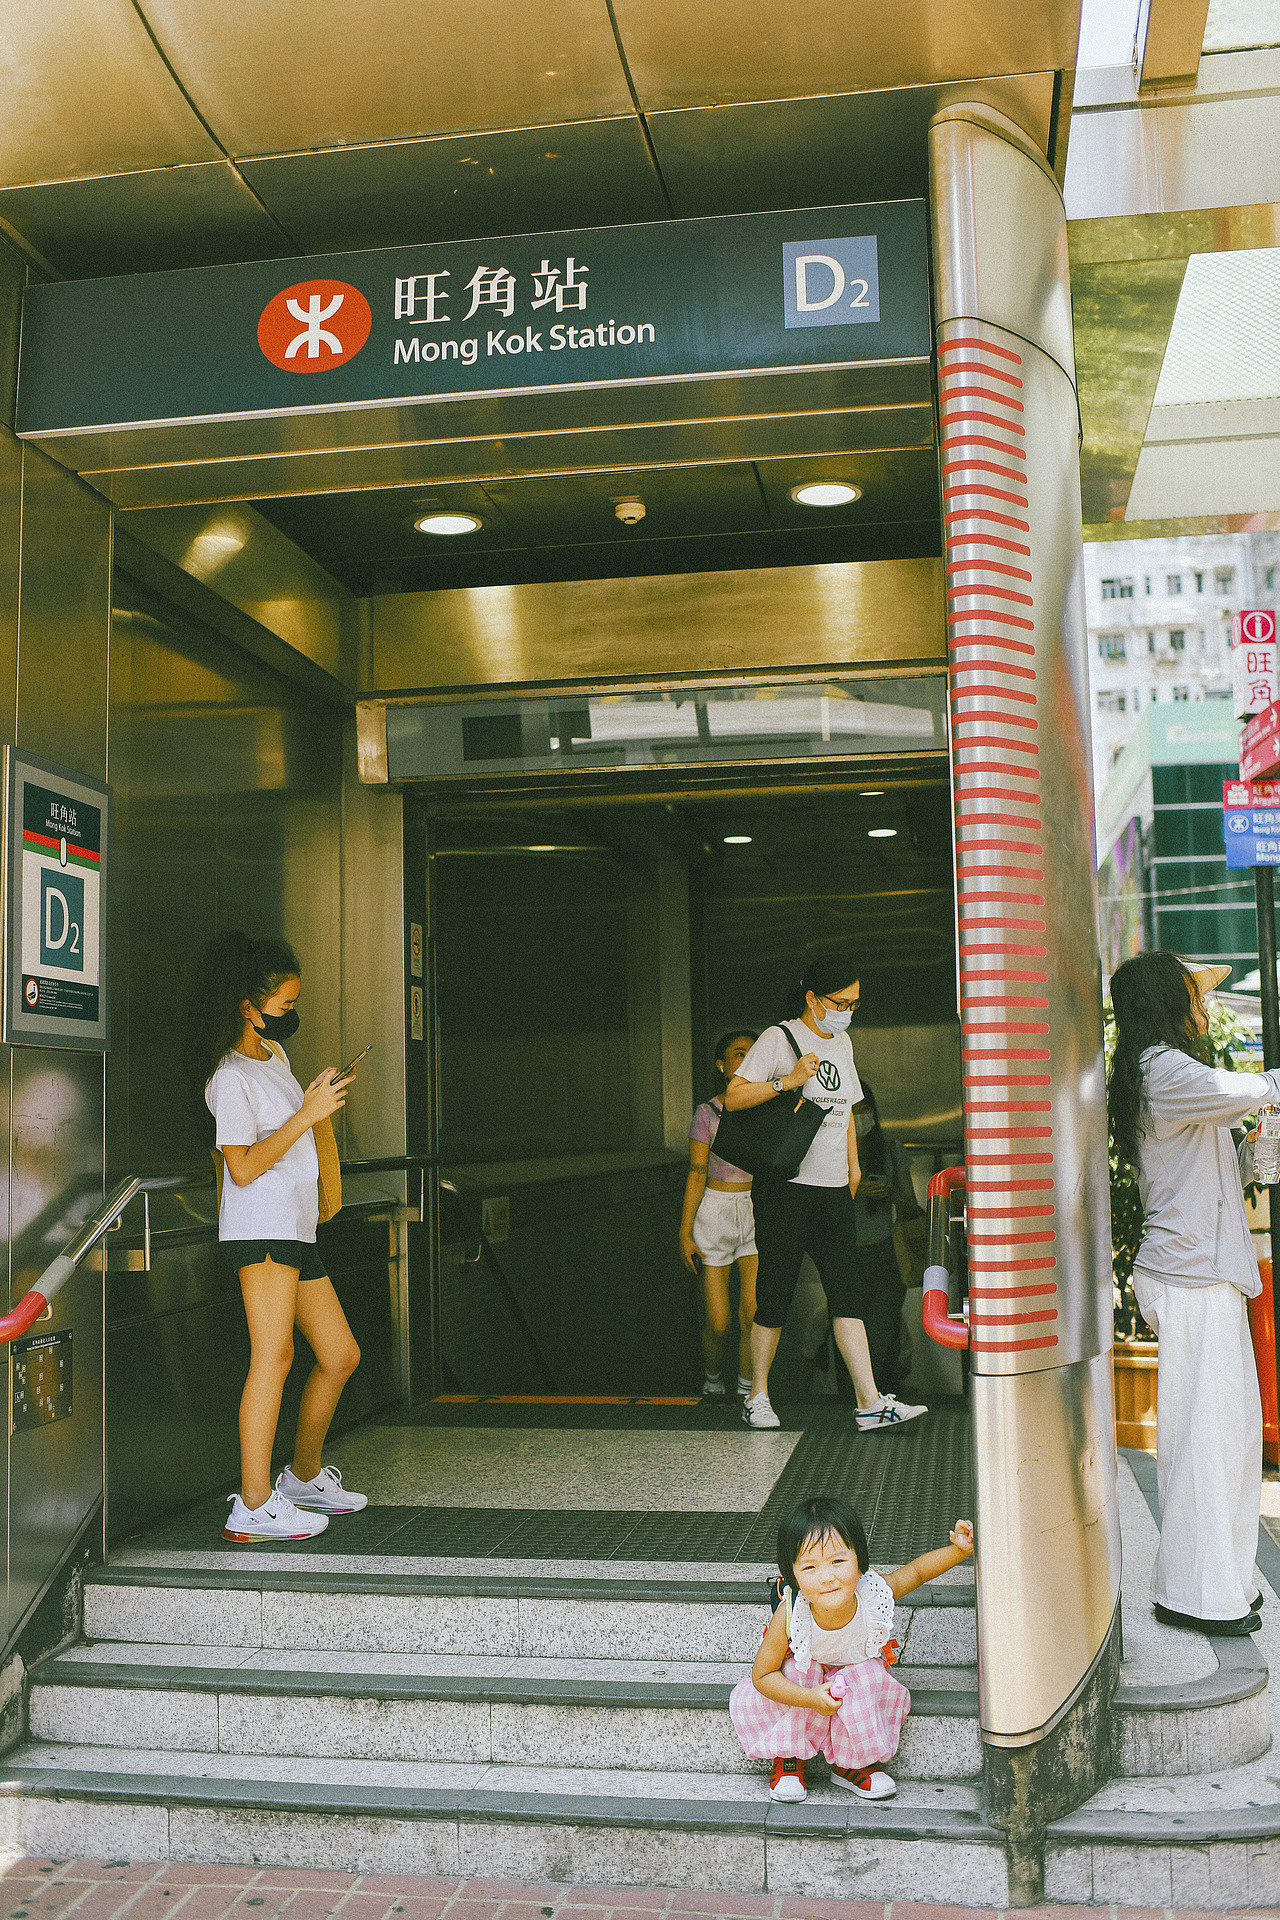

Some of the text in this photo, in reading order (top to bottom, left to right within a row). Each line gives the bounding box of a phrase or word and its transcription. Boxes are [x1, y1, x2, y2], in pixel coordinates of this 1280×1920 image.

[393, 257, 590, 327] 旺角站
[795, 254, 870, 312] D2
[393, 319, 655, 366] Mong Kok Station
[1247, 652, 1273, 706] 旺角
[1252, 796, 1279, 807] Argyle
[50, 802, 77, 826] 旺角站
[45, 818, 82, 838] Mong Kok Station
[1256, 841, 1280, 852] 旺角
[1256, 852, 1280, 864] Mong
[45, 886, 80, 954] D2
[811, 1097, 848, 1105] VOLKSWAGEN
